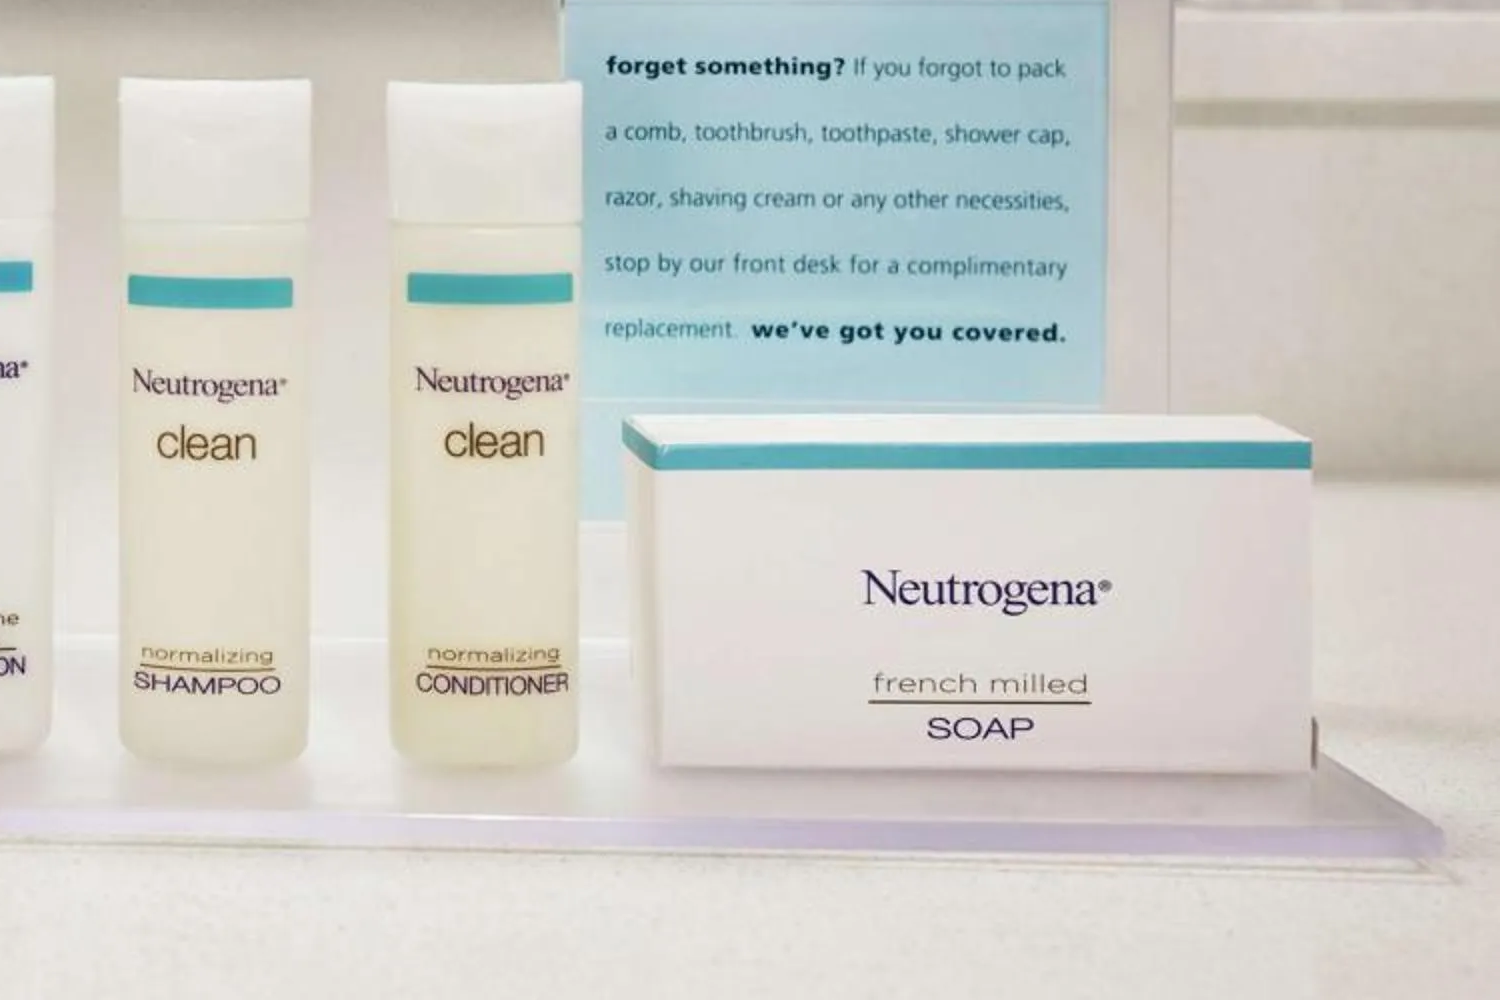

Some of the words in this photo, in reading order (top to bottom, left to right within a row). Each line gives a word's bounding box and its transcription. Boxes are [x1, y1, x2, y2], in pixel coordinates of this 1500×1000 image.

[605, 55, 688, 80] forget
[695, 56, 846, 81] something?
[852, 56, 868, 77] If
[873, 61, 912, 82] you
[918, 56, 983, 83] forgot
[989, 60, 1012, 78] to
[1017, 58, 1066, 82] pack
[605, 125, 618, 141] a
[623, 121, 687, 144] comb,
[694, 121, 814, 145] toothbrush,
[821, 123, 938, 147] toothpaste,
[944, 123, 1022, 145] shower
[1027, 128, 1071, 149] cap,
[605, 190, 663, 209] razor,
[668, 186, 747, 212] shaving
[753, 192, 816, 209] cream
[822, 193, 845, 209] or
[850, 193, 888, 213] any
[892, 189, 949, 210] other
[955, 192, 1070, 213] necessities,
[604, 255, 651, 277] stop
[657, 252, 683, 278] by
[689, 257, 725, 274] our
[733, 252, 785, 274] front
[792, 254, 840, 275] desk
[849, 254, 880, 275] for
[887, 260, 900, 275] a
[906, 256, 1068, 281] complimentary
[751, 320, 830, 340] we've
[839, 322, 885, 345] got
[893, 325, 943, 345] you
[951, 322, 1066, 343] covered.
[156, 423, 257, 461] clean
[443, 421, 545, 459] clean
[139, 646, 274, 666] normalizing
[427, 647, 561, 664] normalizing
[133, 671, 282, 695] SHAMPOO
[415, 672, 569, 697] CONDITIONER
[873, 672, 977, 694] french
[990, 673, 1088, 695] milled
[927, 716, 1035, 741] SOAP
